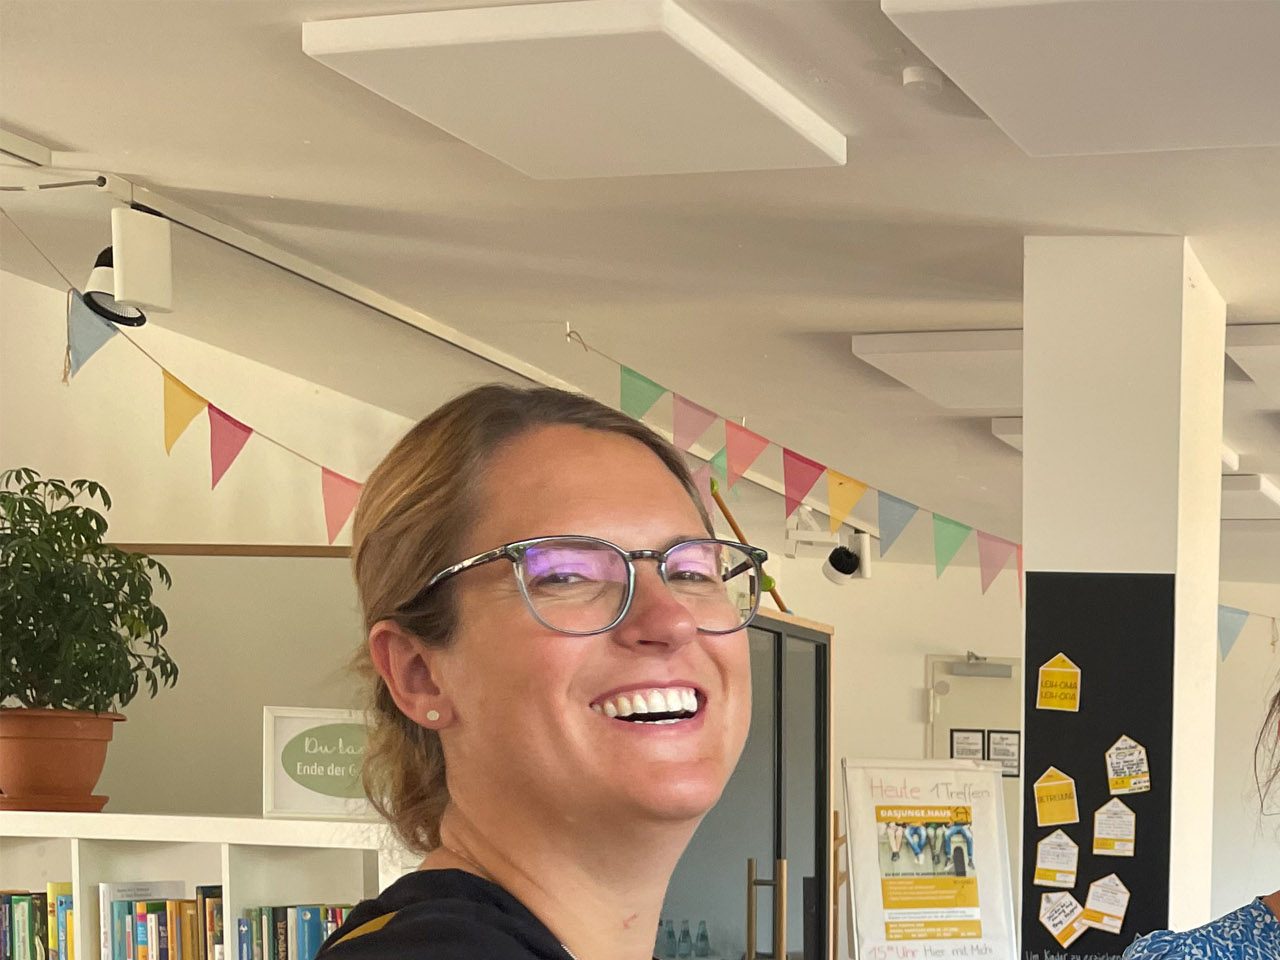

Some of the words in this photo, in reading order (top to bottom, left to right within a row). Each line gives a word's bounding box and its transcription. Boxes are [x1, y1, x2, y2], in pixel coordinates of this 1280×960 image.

[304, 736, 337, 754] Du
[296, 761, 324, 776] Ende
[327, 763, 346, 777] der
[868, 777, 921, 801] Heute
[895, 944, 918, 960] Uhr
[923, 944, 945, 957] Hier
